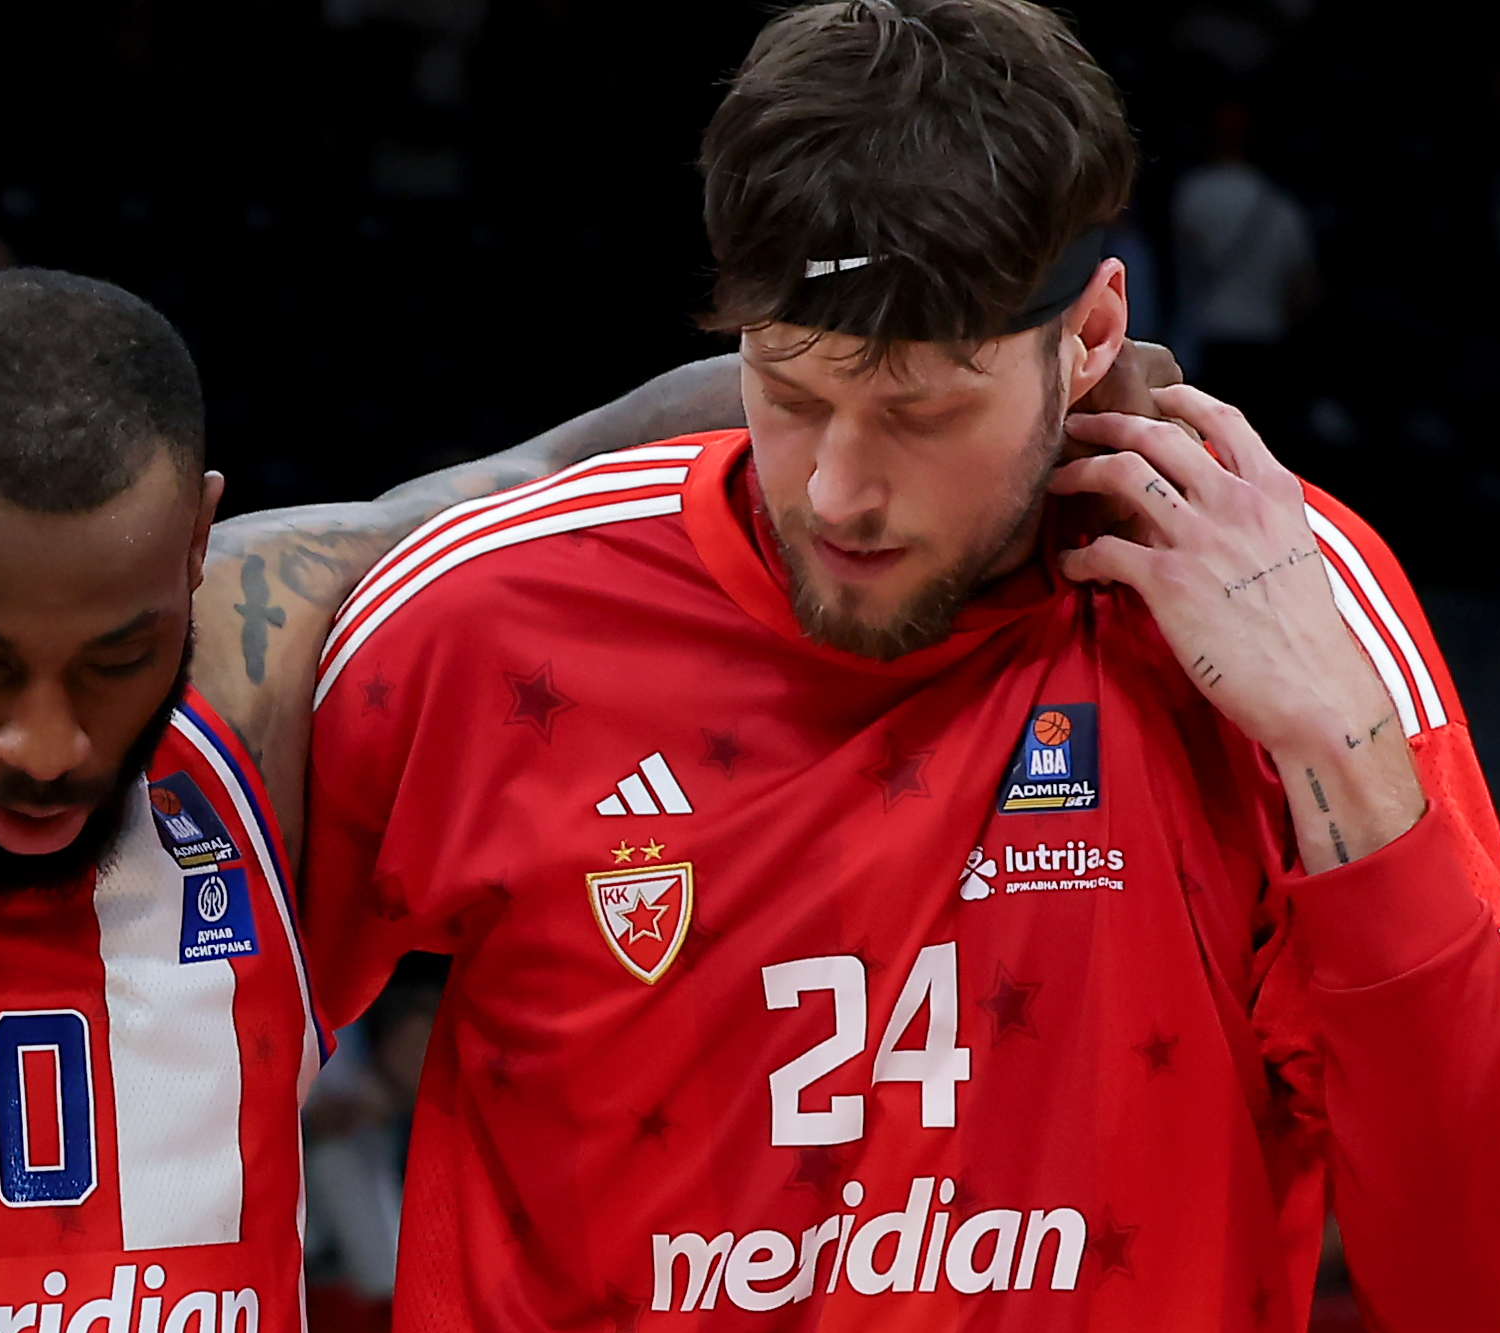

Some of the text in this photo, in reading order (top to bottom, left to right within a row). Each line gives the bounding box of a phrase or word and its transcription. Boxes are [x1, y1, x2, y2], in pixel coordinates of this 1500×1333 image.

[1030, 748, 1068, 776] ABA
[1008, 780, 1096, 799] ADMIRAL
[1065, 795, 1095, 808] BET
[172, 836, 231, 859] ADMIRAL
[604, 886, 630, 906] KK
[1006, 881, 1058, 894] ДРЖАВНА
[197, 927, 233, 943] ДУНАВ
[184, 940, 252, 958] ОСИГУРАЊЕ
[762, 942, 970, 1147] 24
[650, 1176, 1087, 1312] meridian
